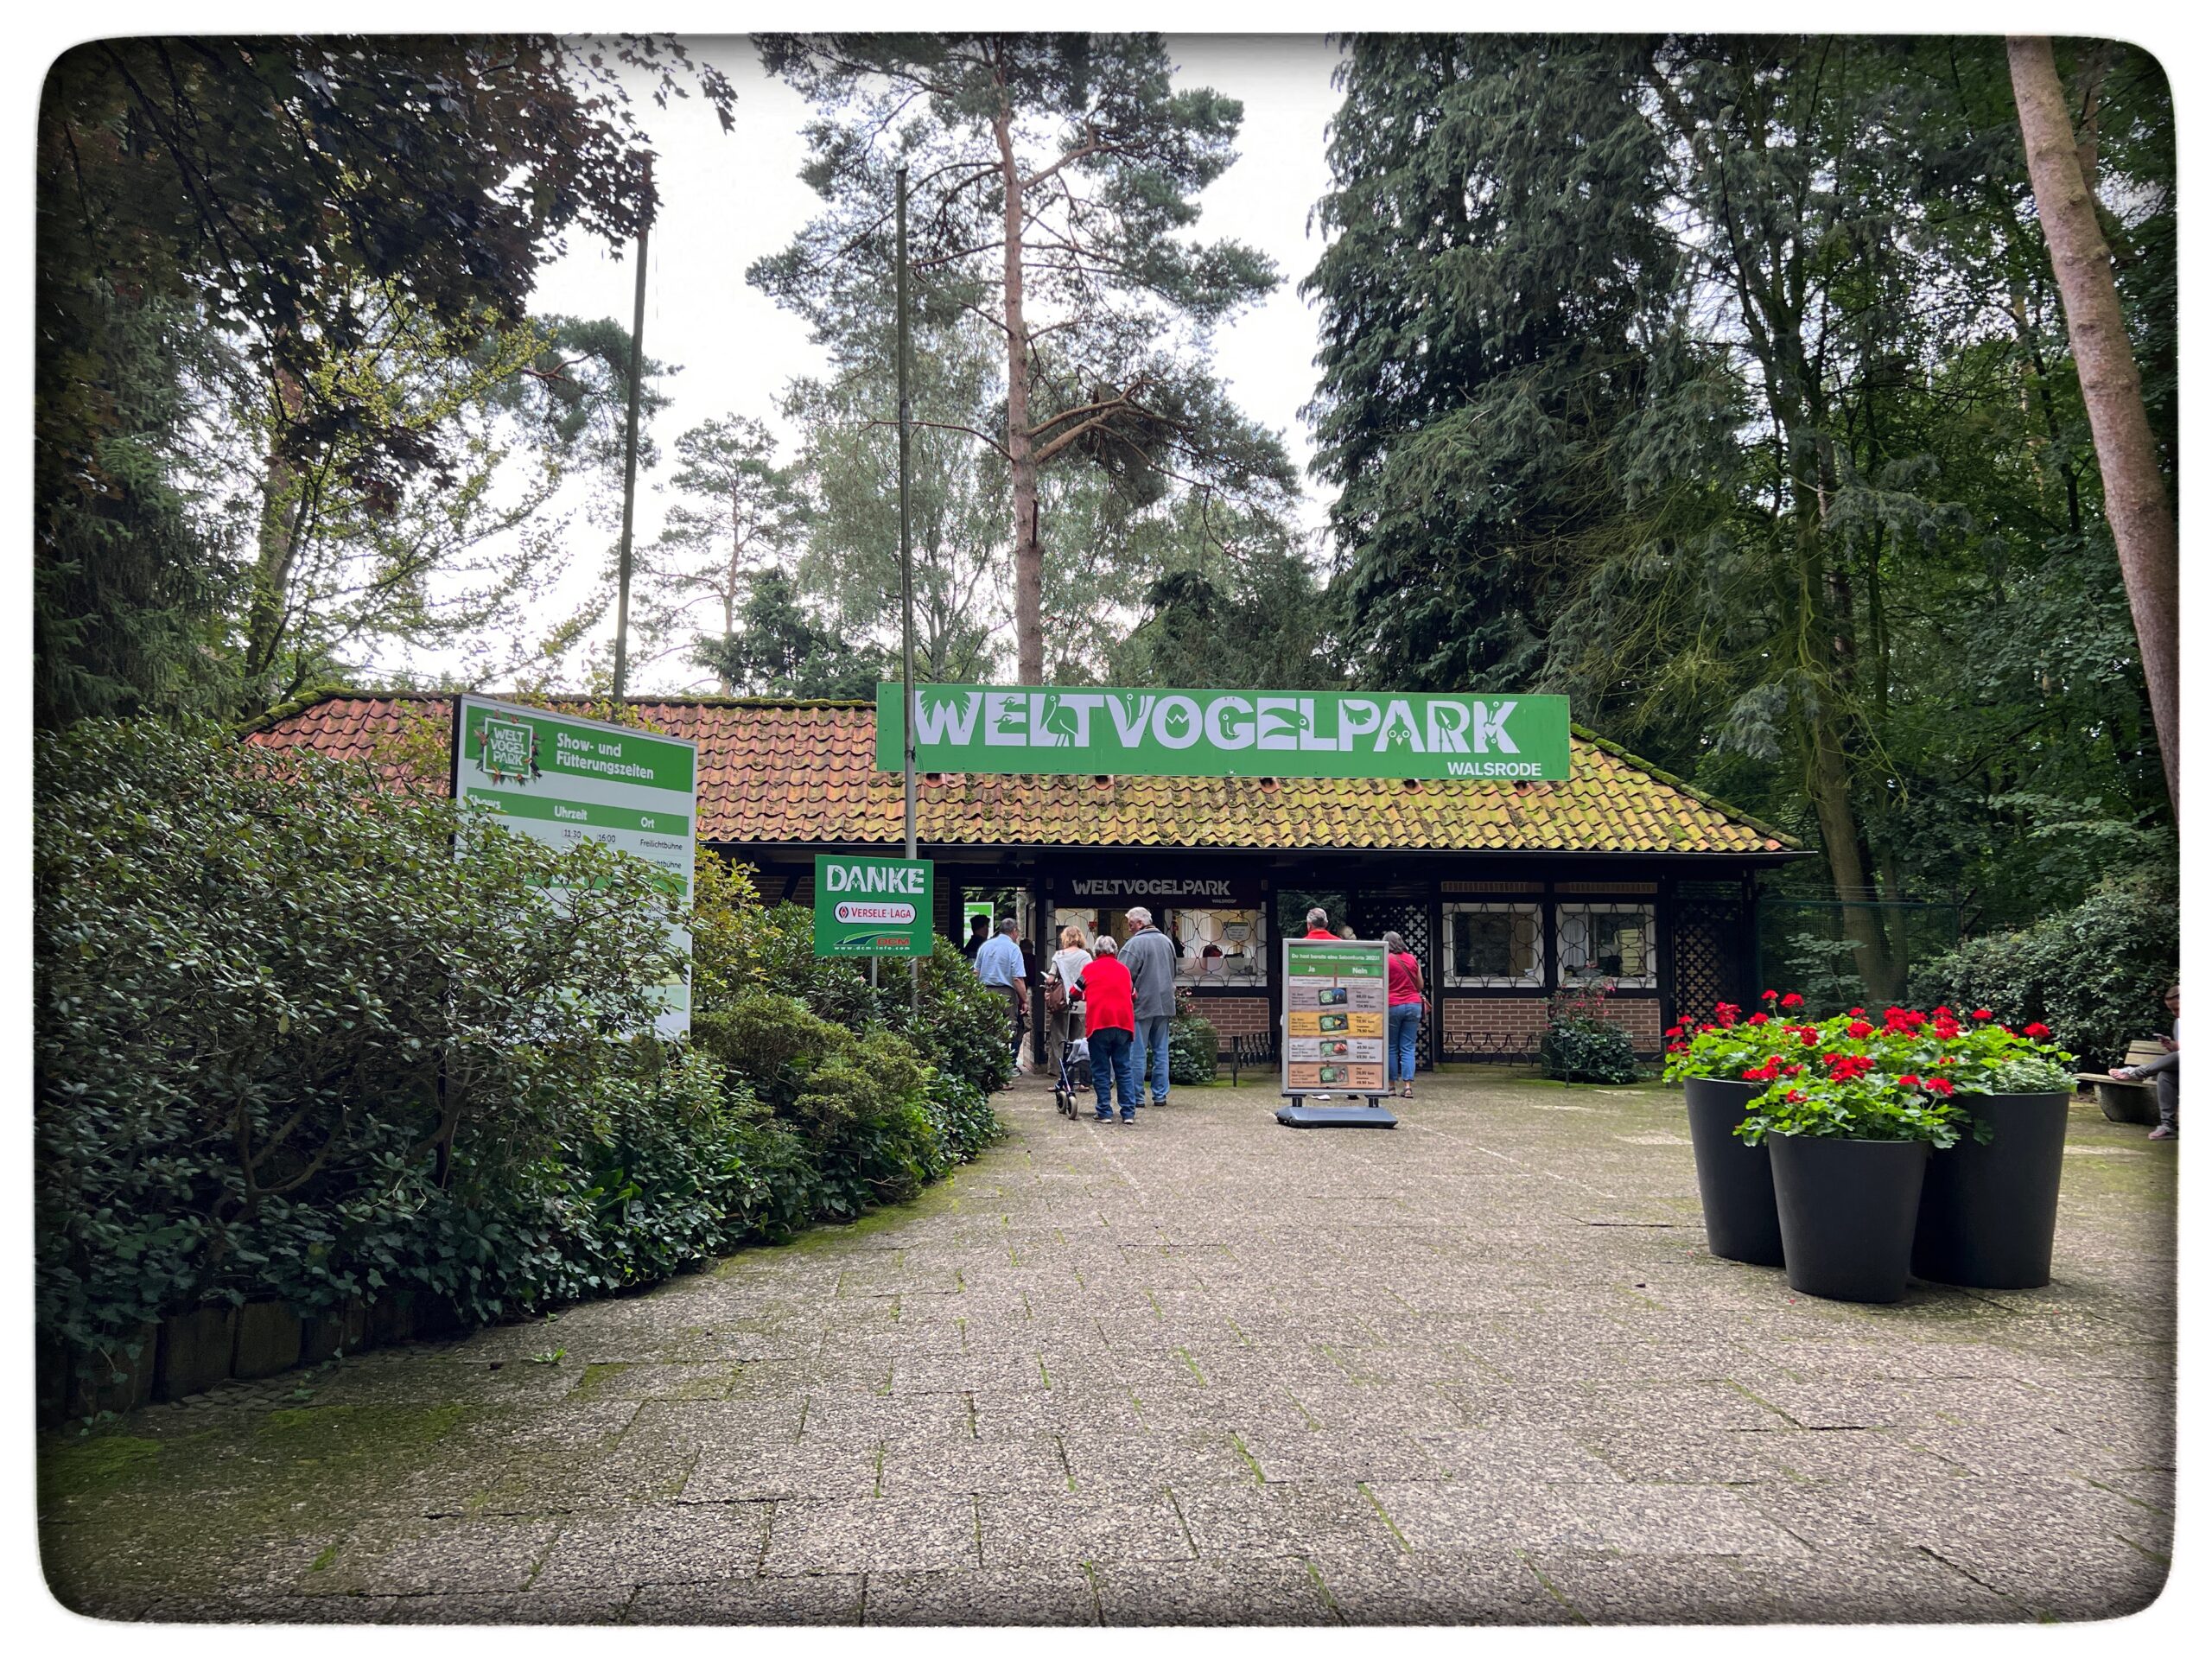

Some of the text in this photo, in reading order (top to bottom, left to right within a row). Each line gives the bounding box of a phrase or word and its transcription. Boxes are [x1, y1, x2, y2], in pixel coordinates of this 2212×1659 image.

[914, 691, 1521, 753] WELTVOGELPARK
[493, 727, 524, 743] WELT
[490, 739, 527, 755] VOGEL
[556, 732, 622, 758] Show- und
[493, 750, 524, 766] PARK
[556, 750, 654, 780] Fütterungszeiten
[1447, 761, 1542, 777] WALSRODE
[554, 805, 588, 821] Uhrzeit
[640, 817, 655, 829] Ort
[564, 829, 616, 843] 11:30 16:00
[639, 838, 683, 851] Freilichtbühne
[827, 864, 925, 894] DANKE
[1071, 879, 1230, 896] WELTVOGELPARK
[876, 938, 911, 946] DCM
